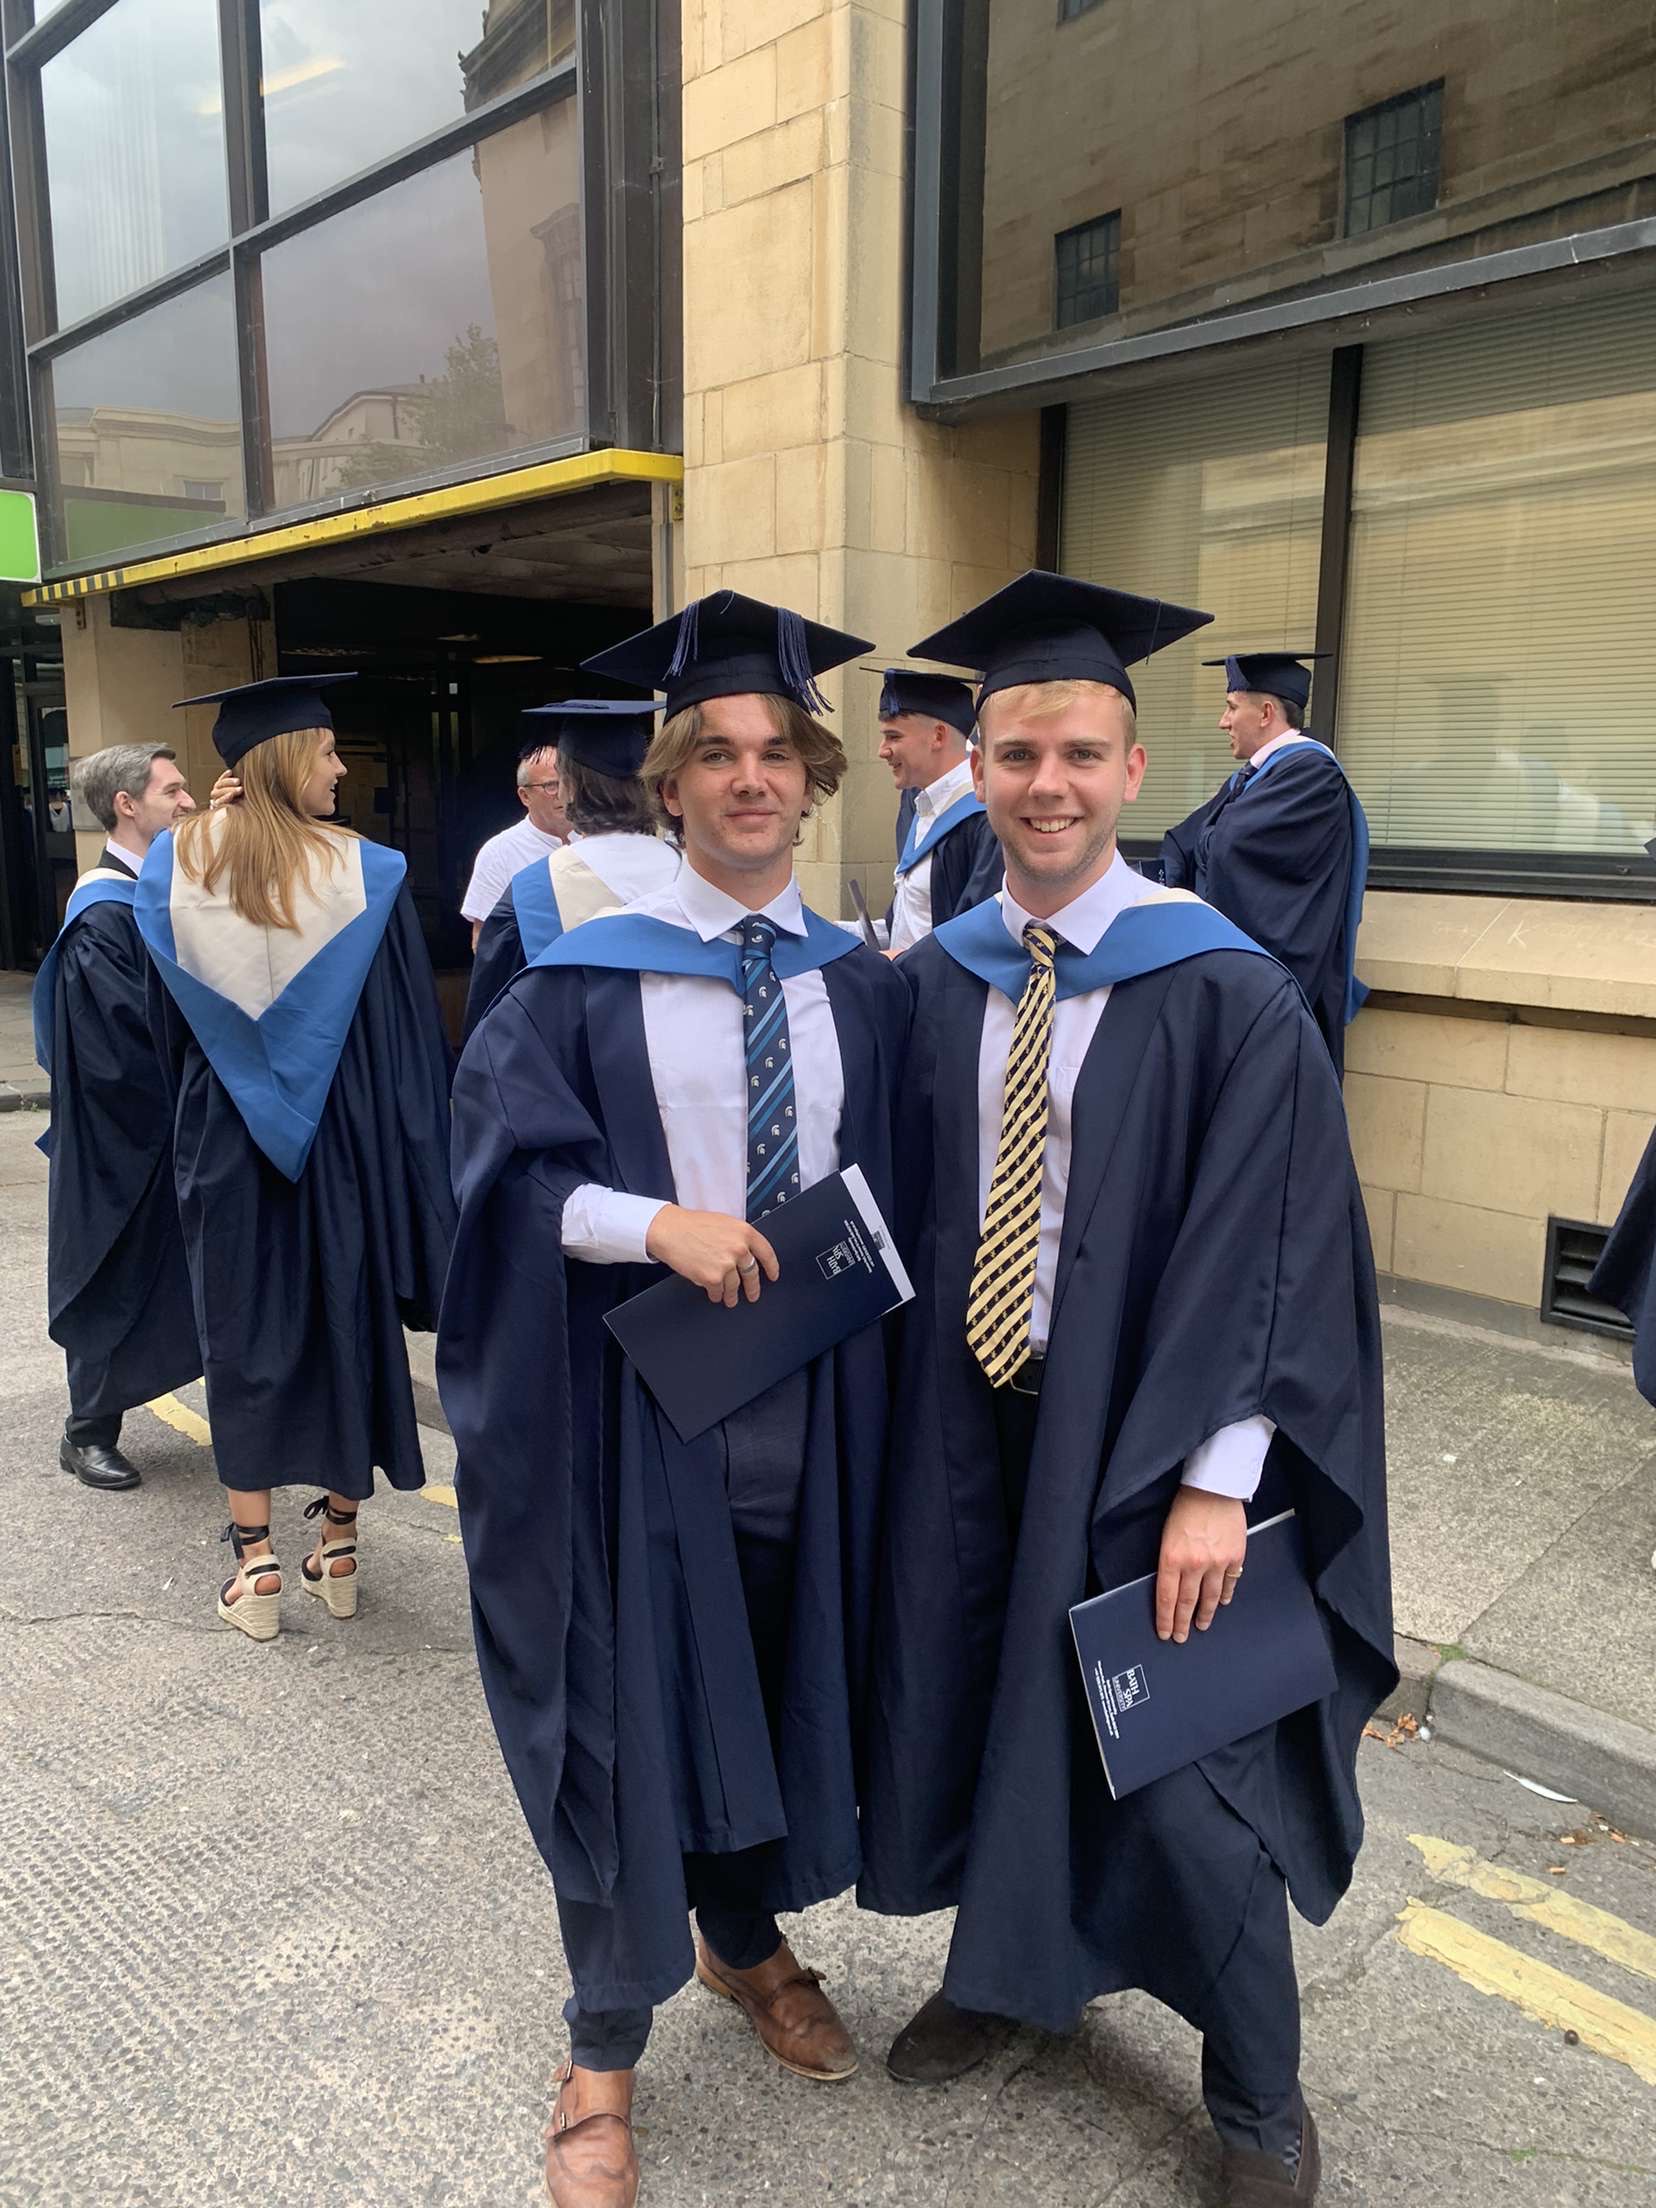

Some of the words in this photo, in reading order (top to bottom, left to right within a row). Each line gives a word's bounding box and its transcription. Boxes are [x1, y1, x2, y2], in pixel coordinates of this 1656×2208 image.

[832, 1244, 844, 1260] SPA
[827, 1256, 841, 1275] BATH
[1126, 1668, 1140, 1696] BATH
[1123, 1688, 1134, 1708] SPA
